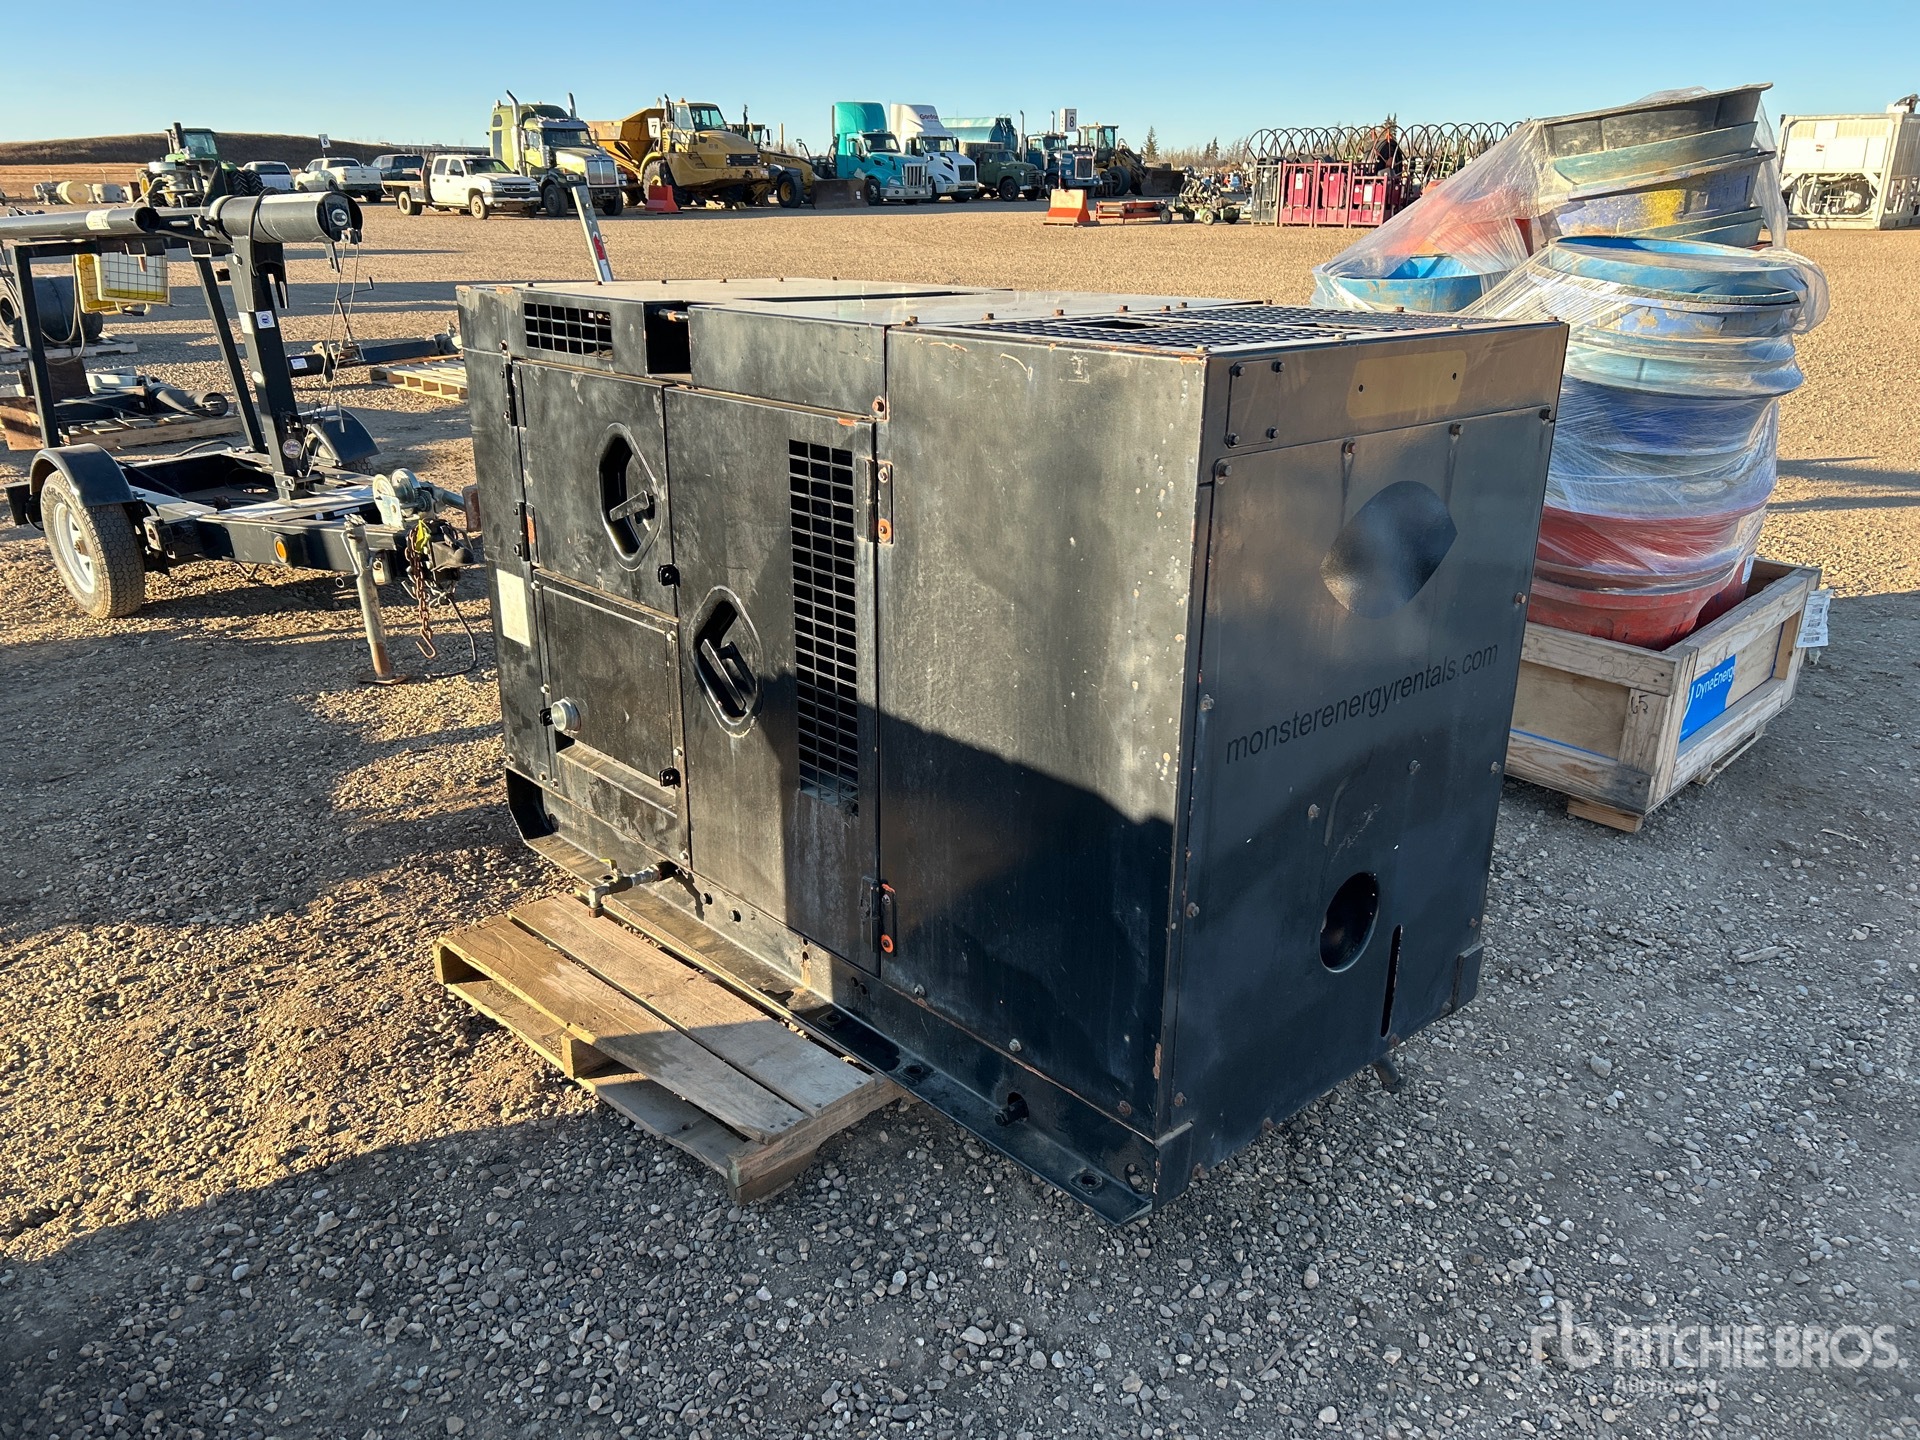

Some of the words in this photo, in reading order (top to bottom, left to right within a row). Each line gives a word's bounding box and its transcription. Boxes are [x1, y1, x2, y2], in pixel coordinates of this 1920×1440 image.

[1069, 116, 1074, 127] 8
[651, 124, 657, 134] 7
[1226, 643, 1499, 765] monsterenergyrentals.com
